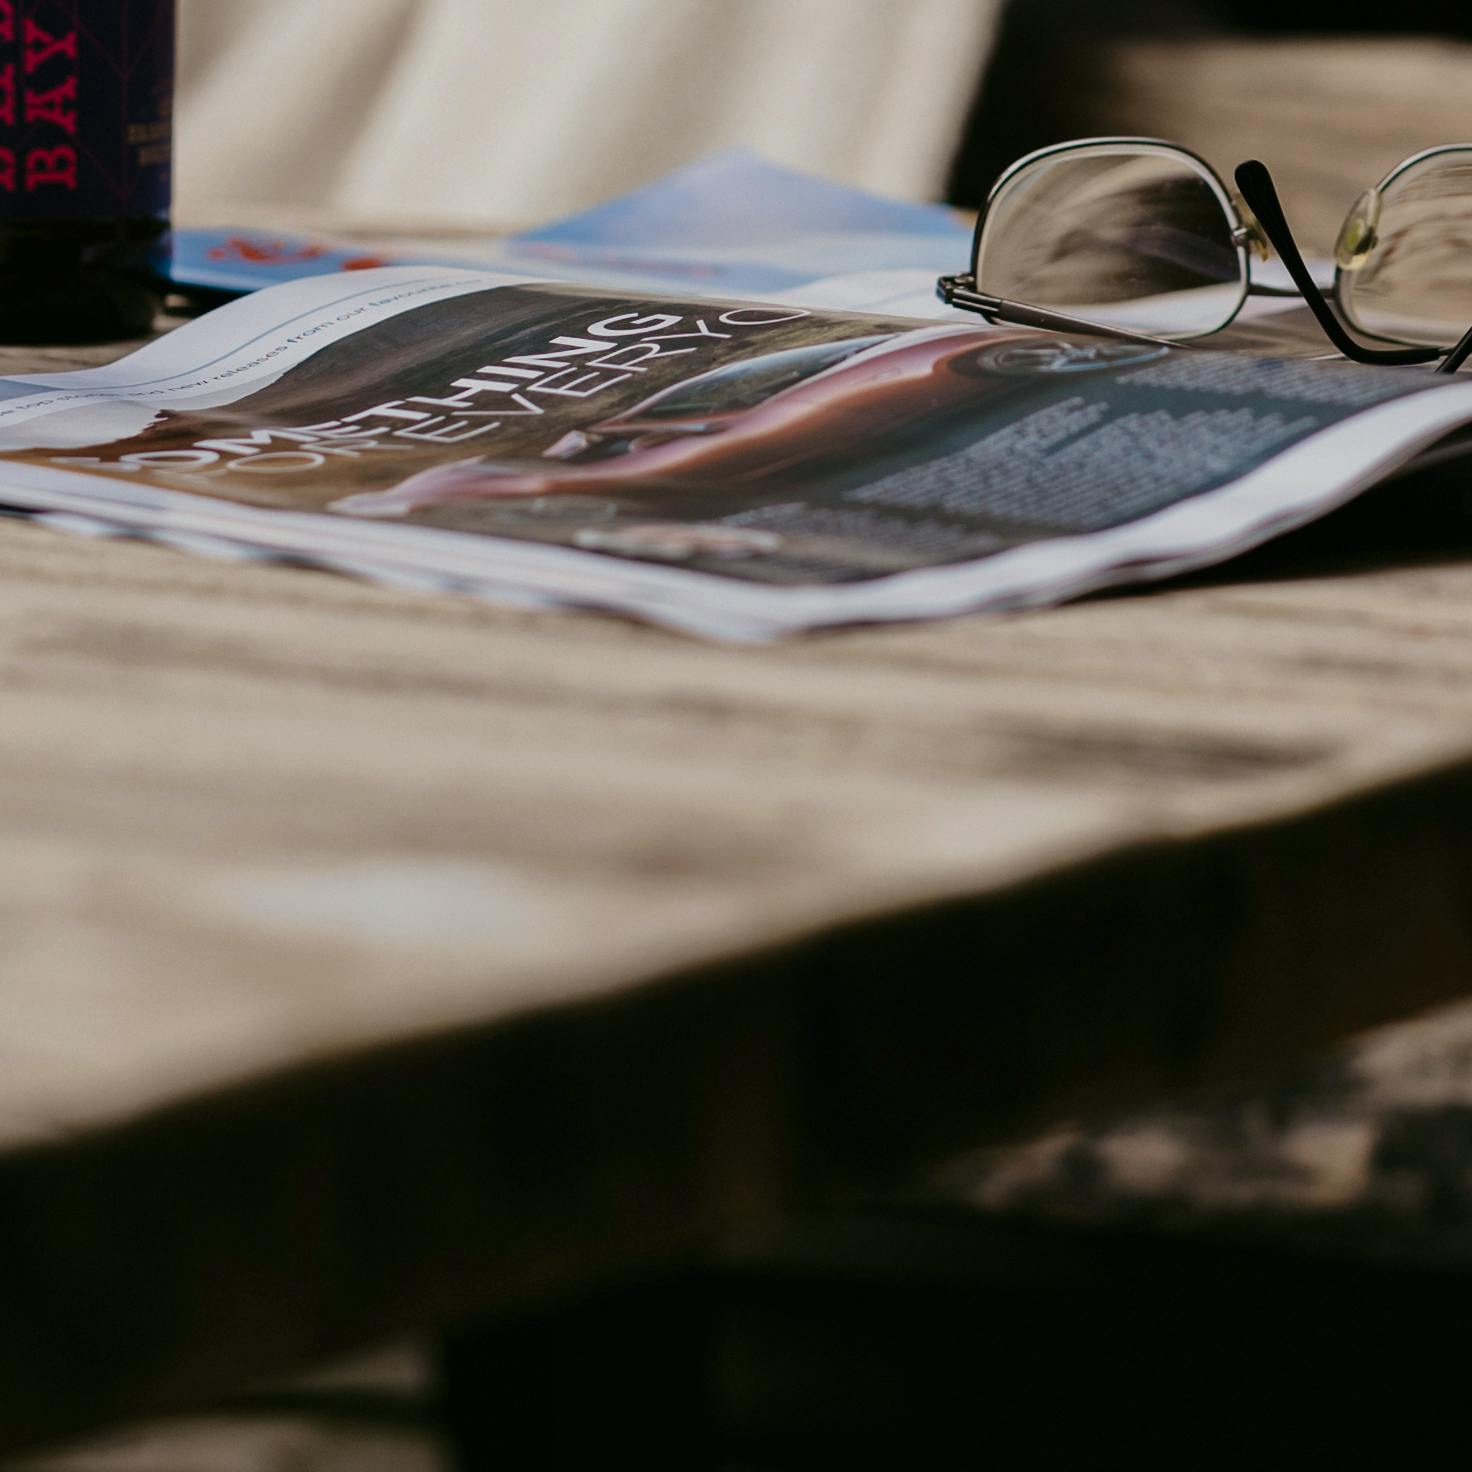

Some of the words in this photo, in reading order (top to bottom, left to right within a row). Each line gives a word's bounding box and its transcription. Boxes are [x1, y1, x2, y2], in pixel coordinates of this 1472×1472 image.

[22, 18, 78, 190] BAY
[16, 399, 55, 411] top
[167, 379, 209, 392] new
[212, 346, 288, 380] releases
[286, 321, 335, 344] from
[336, 307, 368, 321] our
[50, 312, 684, 473] SOMETHING
